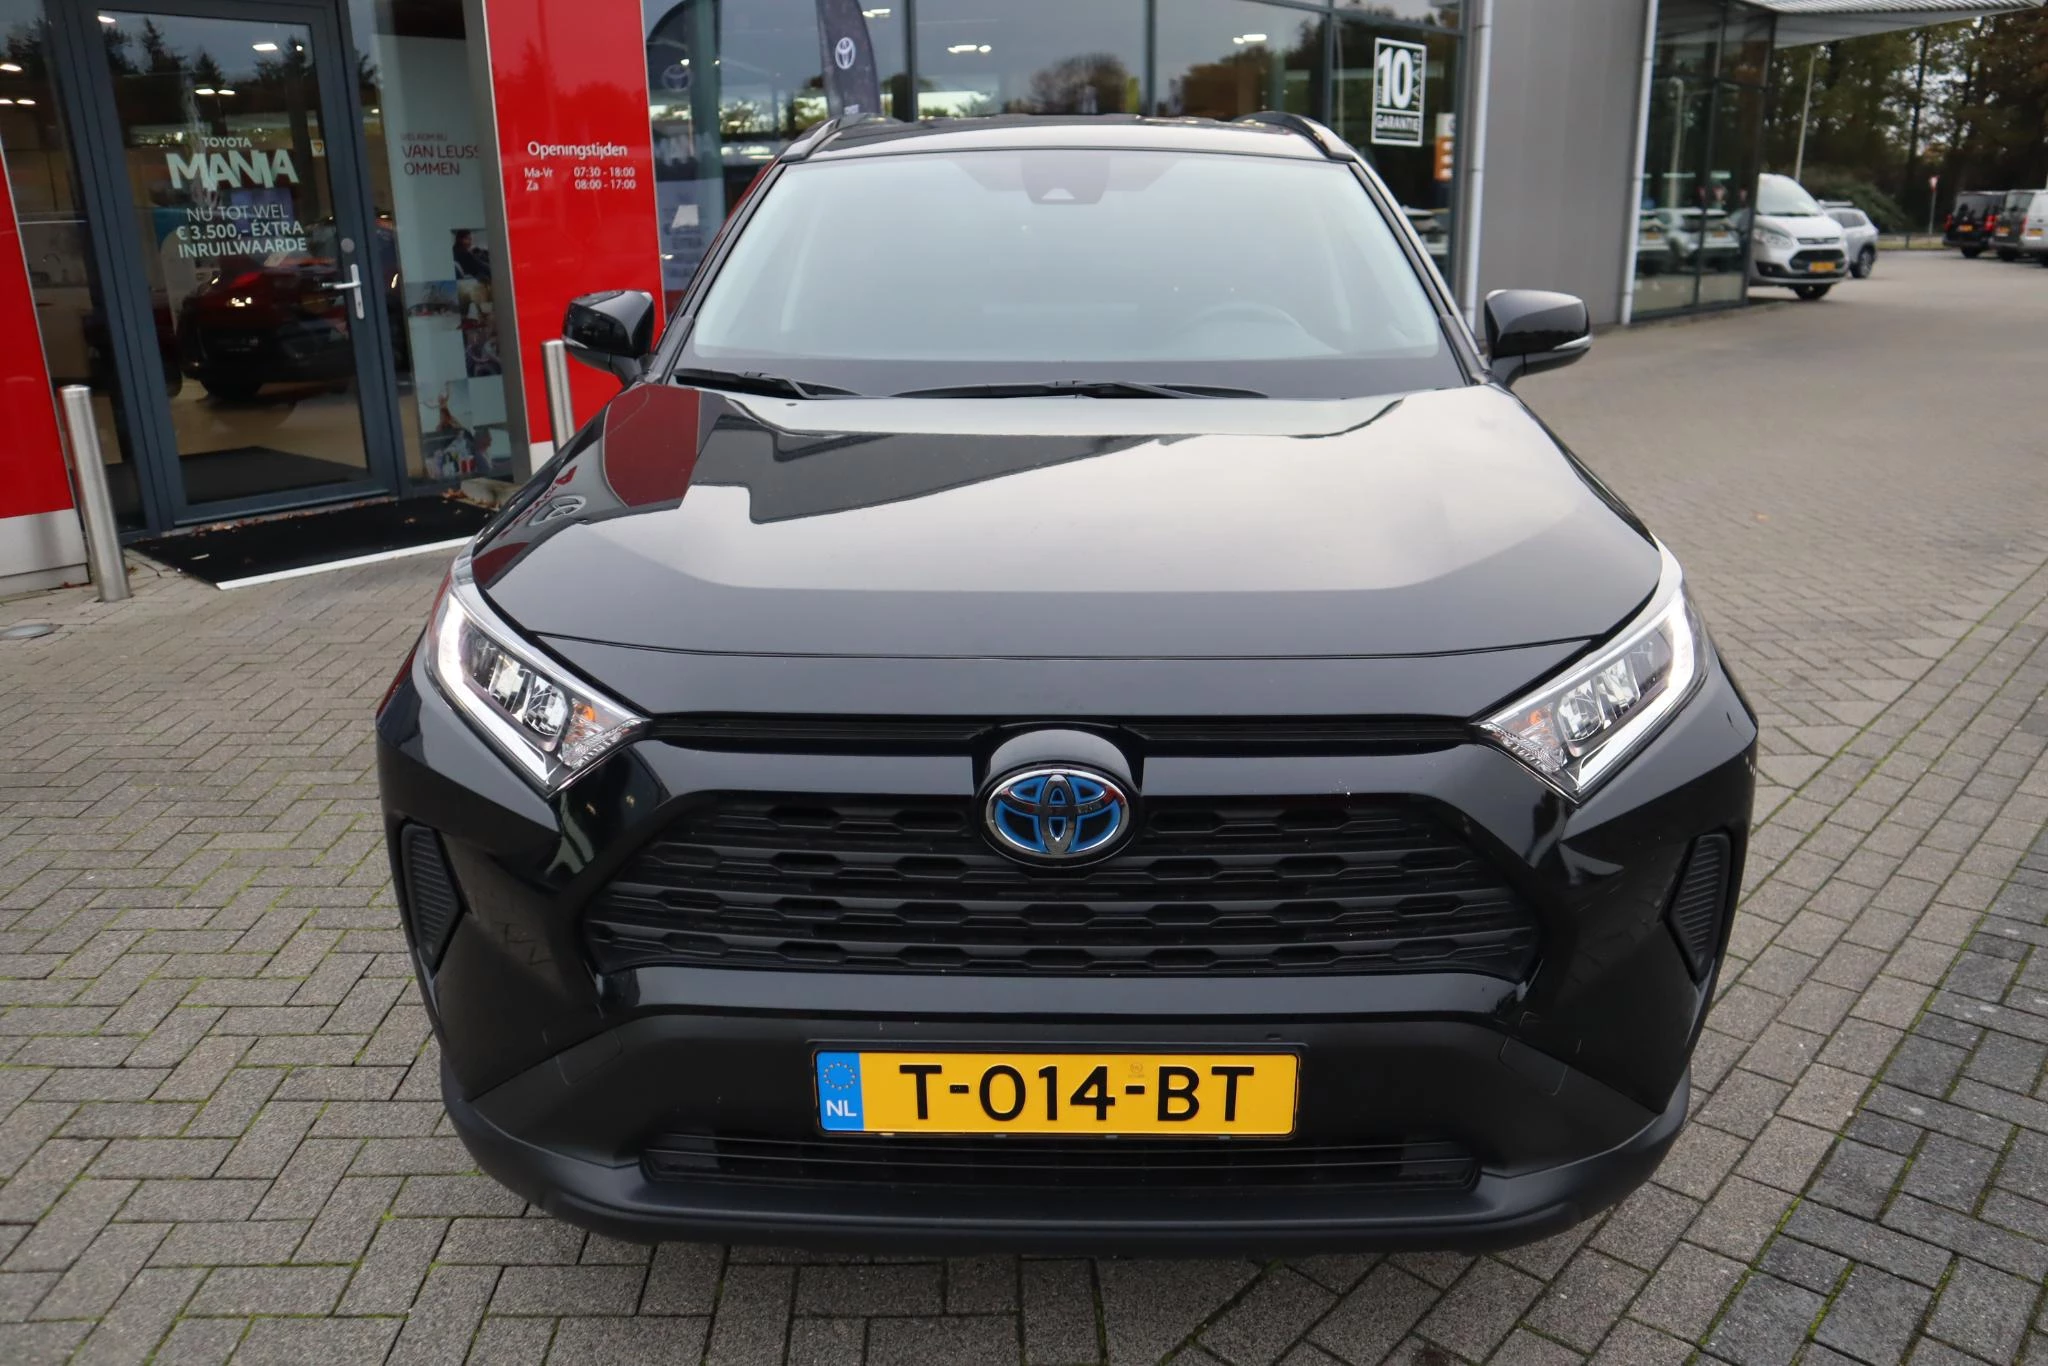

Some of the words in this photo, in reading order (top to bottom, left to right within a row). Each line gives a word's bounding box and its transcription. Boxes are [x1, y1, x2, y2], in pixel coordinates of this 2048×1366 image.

[1378, 47, 1413, 109] 10
[1376, 114, 1419, 132] GARANTIE
[201, 136, 252, 148] TOYOTA
[401, 144, 434, 158] VAN
[527, 141, 628, 160] Openingstijden
[166, 149, 299, 191] MANIA
[404, 161, 460, 176] OMMEN
[524, 167, 553, 178] Ma-Vr
[573, 166, 601, 177] 07:30
[609, 166, 636, 177] 18:00
[526, 180, 539, 191] Za
[574, 179, 602, 190] 08:00
[611, 179, 637, 190] 17:00
[186, 207, 213, 222] NU
[217, 205, 248, 219] TOT
[254, 204, 289, 219] WEL
[178, 238, 308, 258] INRUILWAARDE
[899, 1064, 1255, 1122] T-014-BT
[826, 1099, 857, 1117] NL
